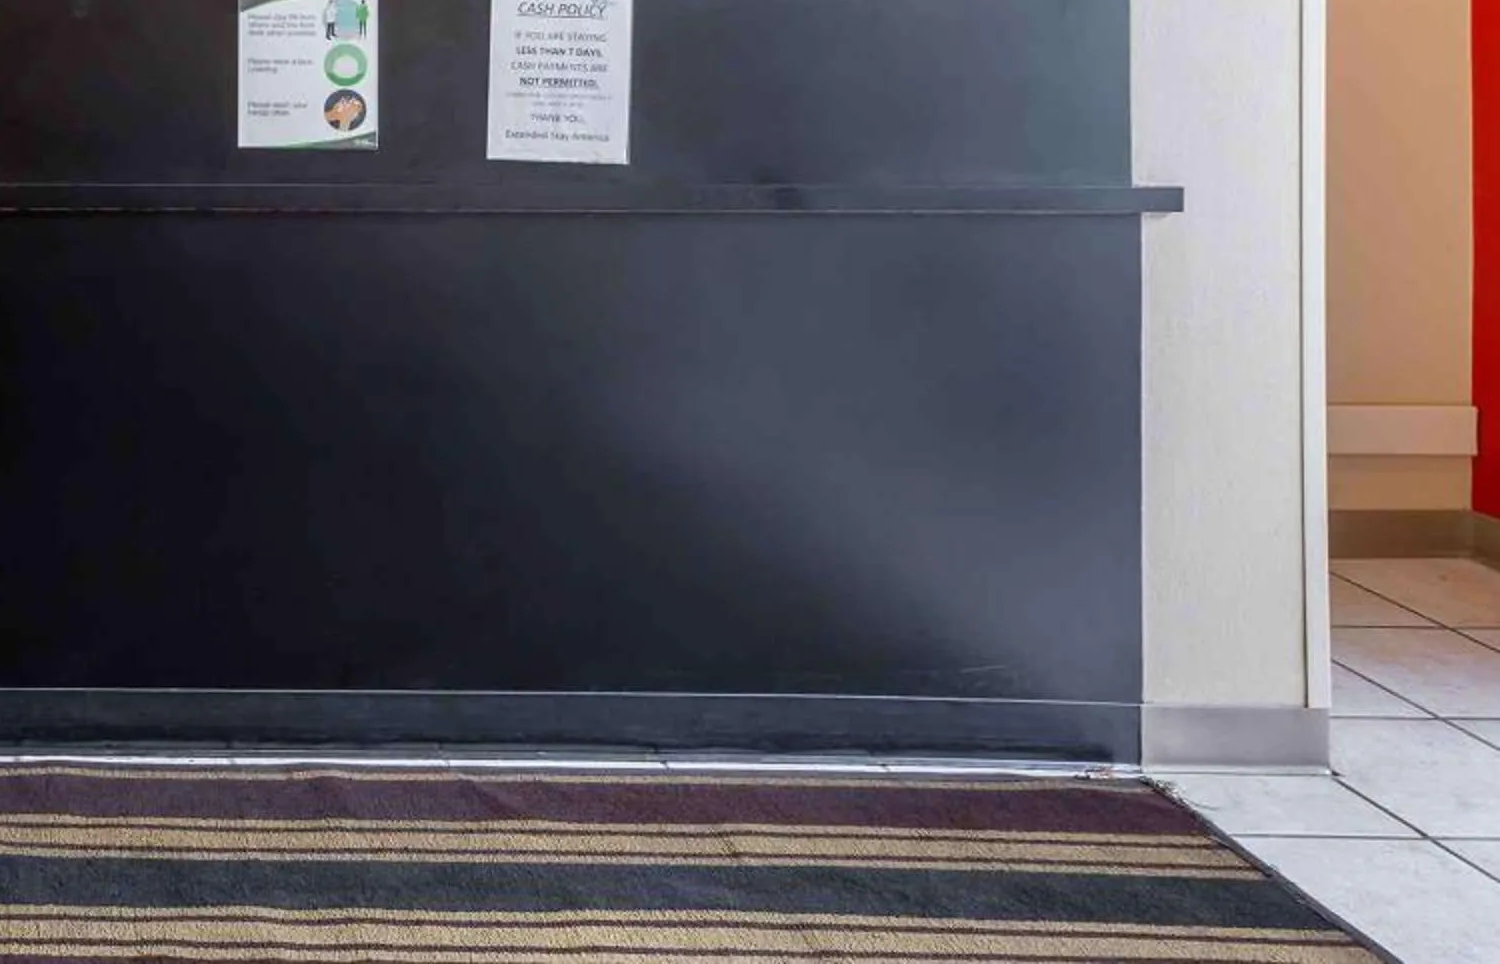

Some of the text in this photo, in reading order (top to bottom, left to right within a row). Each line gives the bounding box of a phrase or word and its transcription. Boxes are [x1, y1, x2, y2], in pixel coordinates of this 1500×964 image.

[516, 1, 608, 18] CASH POLICY
[567, 32, 608, 43] STAYING
[516, 45, 537, 56] LESS
[540, 46, 566, 56] THAN
[510, 61, 536, 71] CASH
[537, 62, 589, 72] PAYMENTS
[519, 77, 540, 87] NOT
[505, 129, 549, 139] Extended
